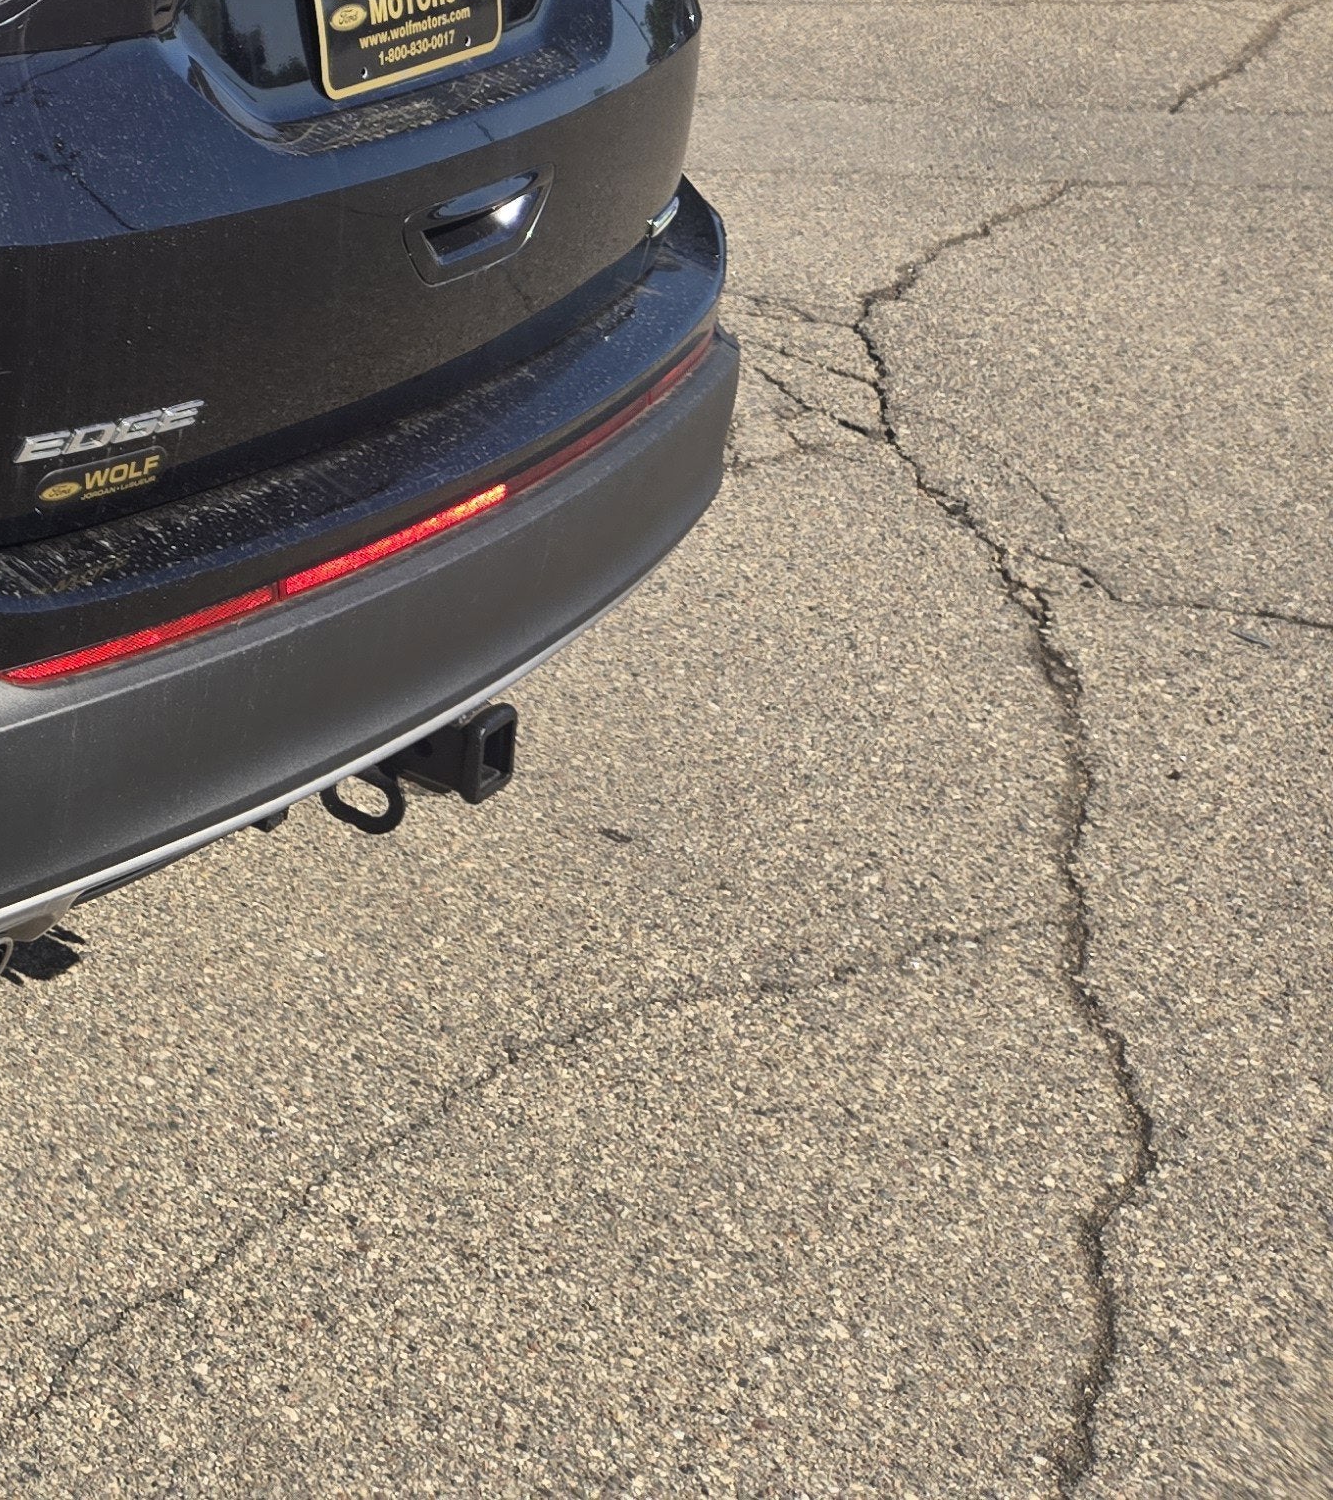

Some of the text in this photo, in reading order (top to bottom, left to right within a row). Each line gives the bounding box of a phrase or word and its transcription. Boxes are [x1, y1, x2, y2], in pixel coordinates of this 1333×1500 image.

[358, 6, 471, 50] www.wolfmotors.com
[378, 29, 455, 66] 1-800-830-0017
[12, 399, 205, 464] EDGE
[84, 454, 160, 490] WOLF
